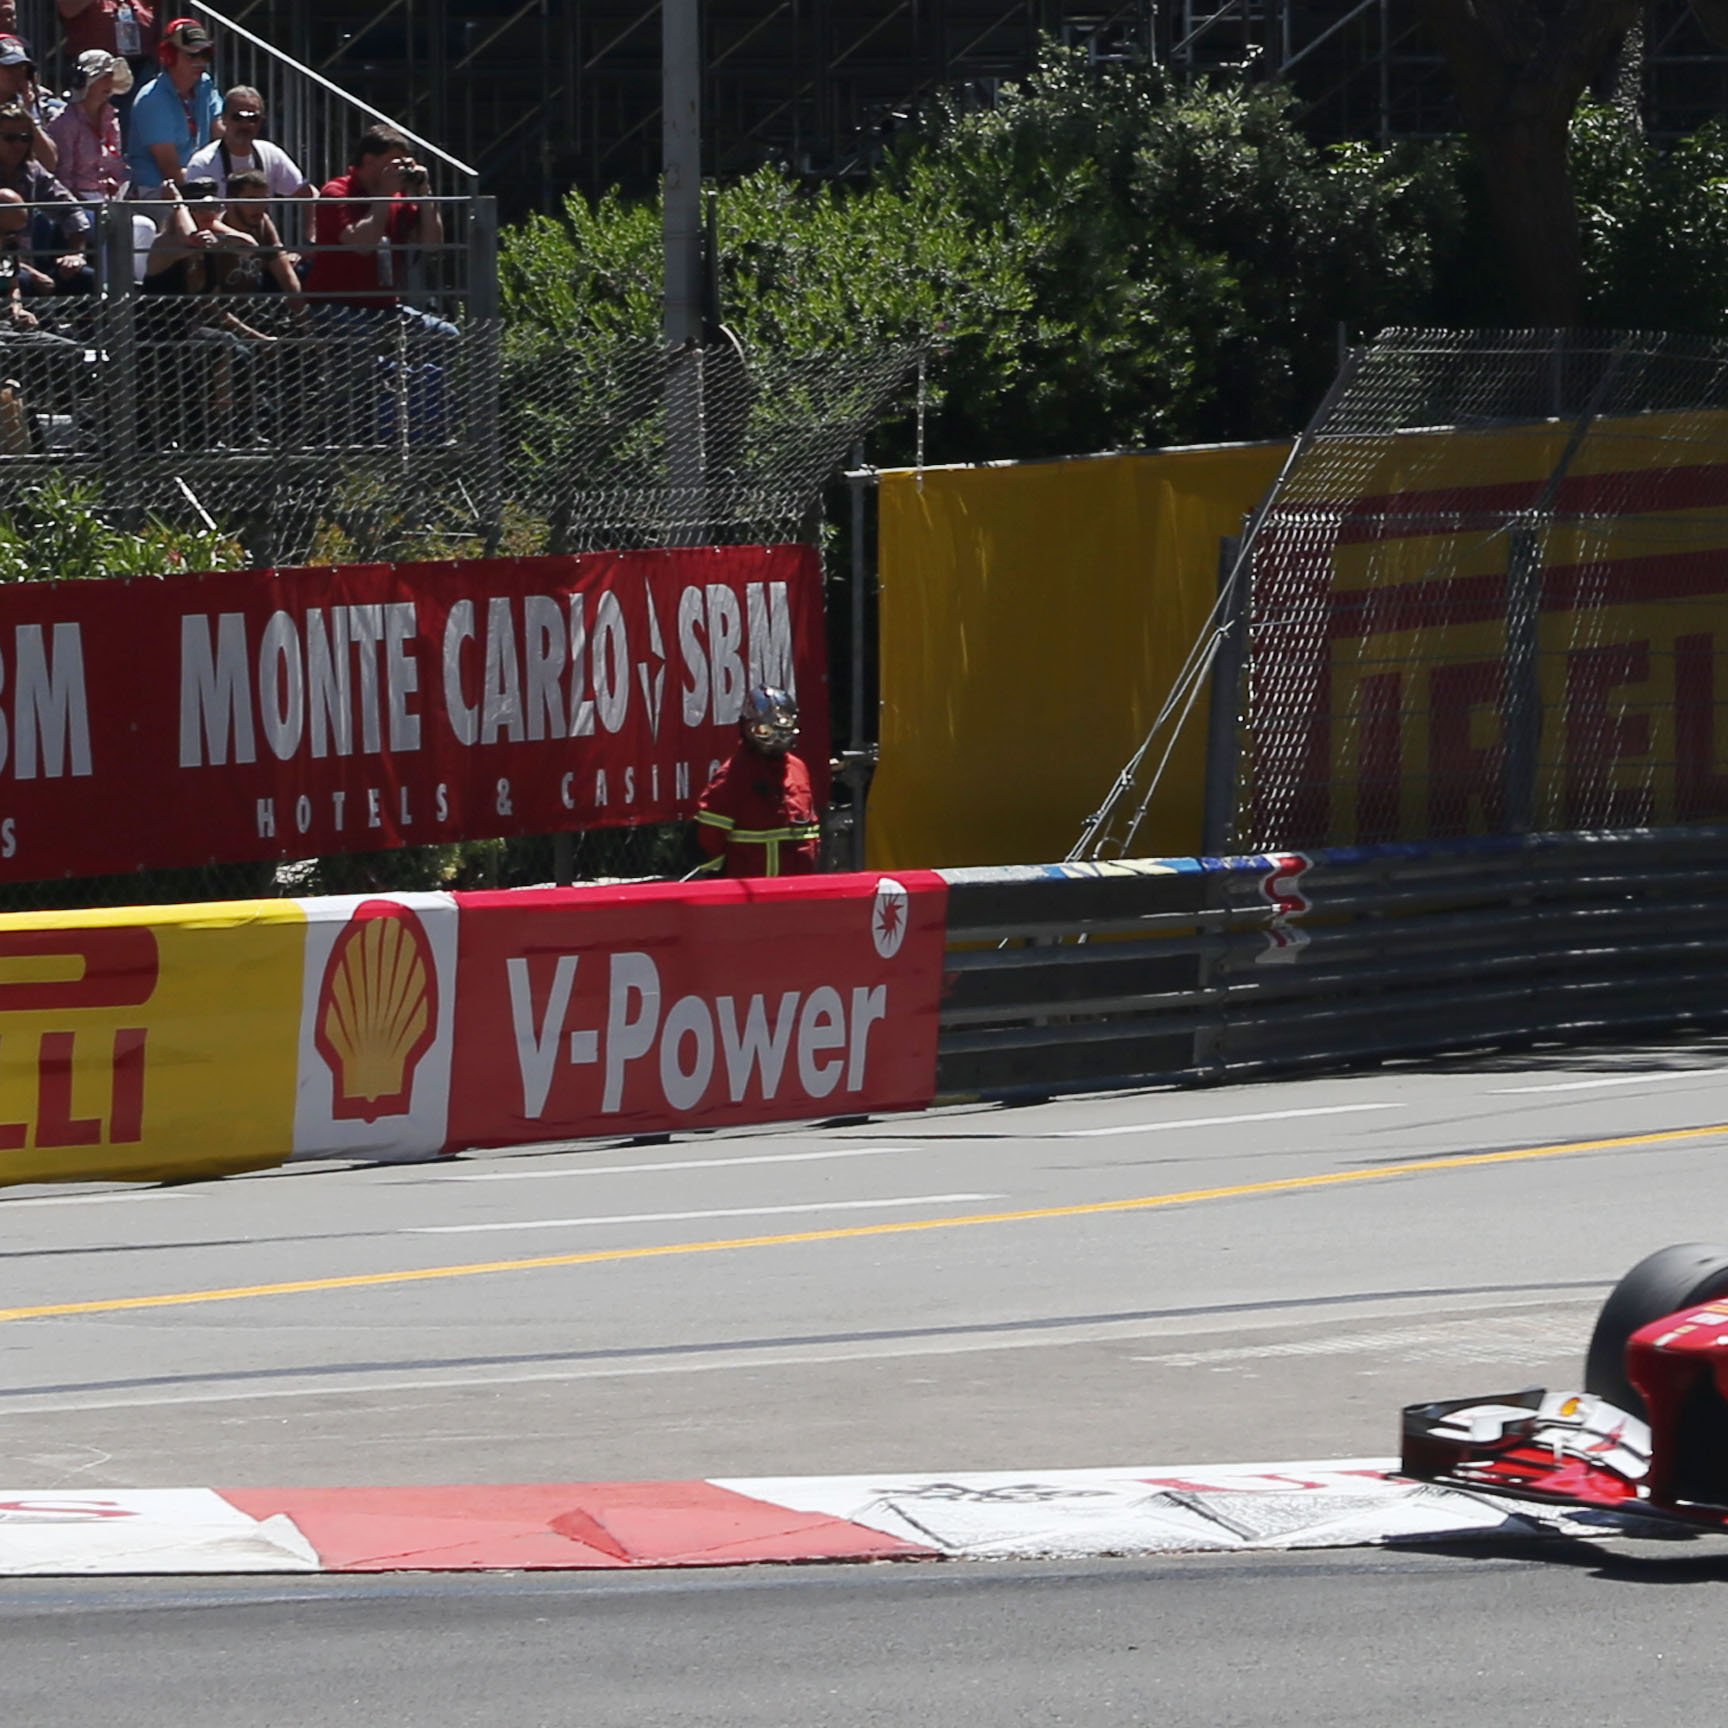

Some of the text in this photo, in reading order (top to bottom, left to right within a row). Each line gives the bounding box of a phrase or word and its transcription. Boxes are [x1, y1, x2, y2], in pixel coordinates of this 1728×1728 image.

[0, 622, 93, 779] M
[179, 581, 797, 768] MONTE CARLO SBM
[256, 782, 448, 838] HOTELS
[496, 778, 513, 816] &
[507, 951, 888, 1120] V-Power
